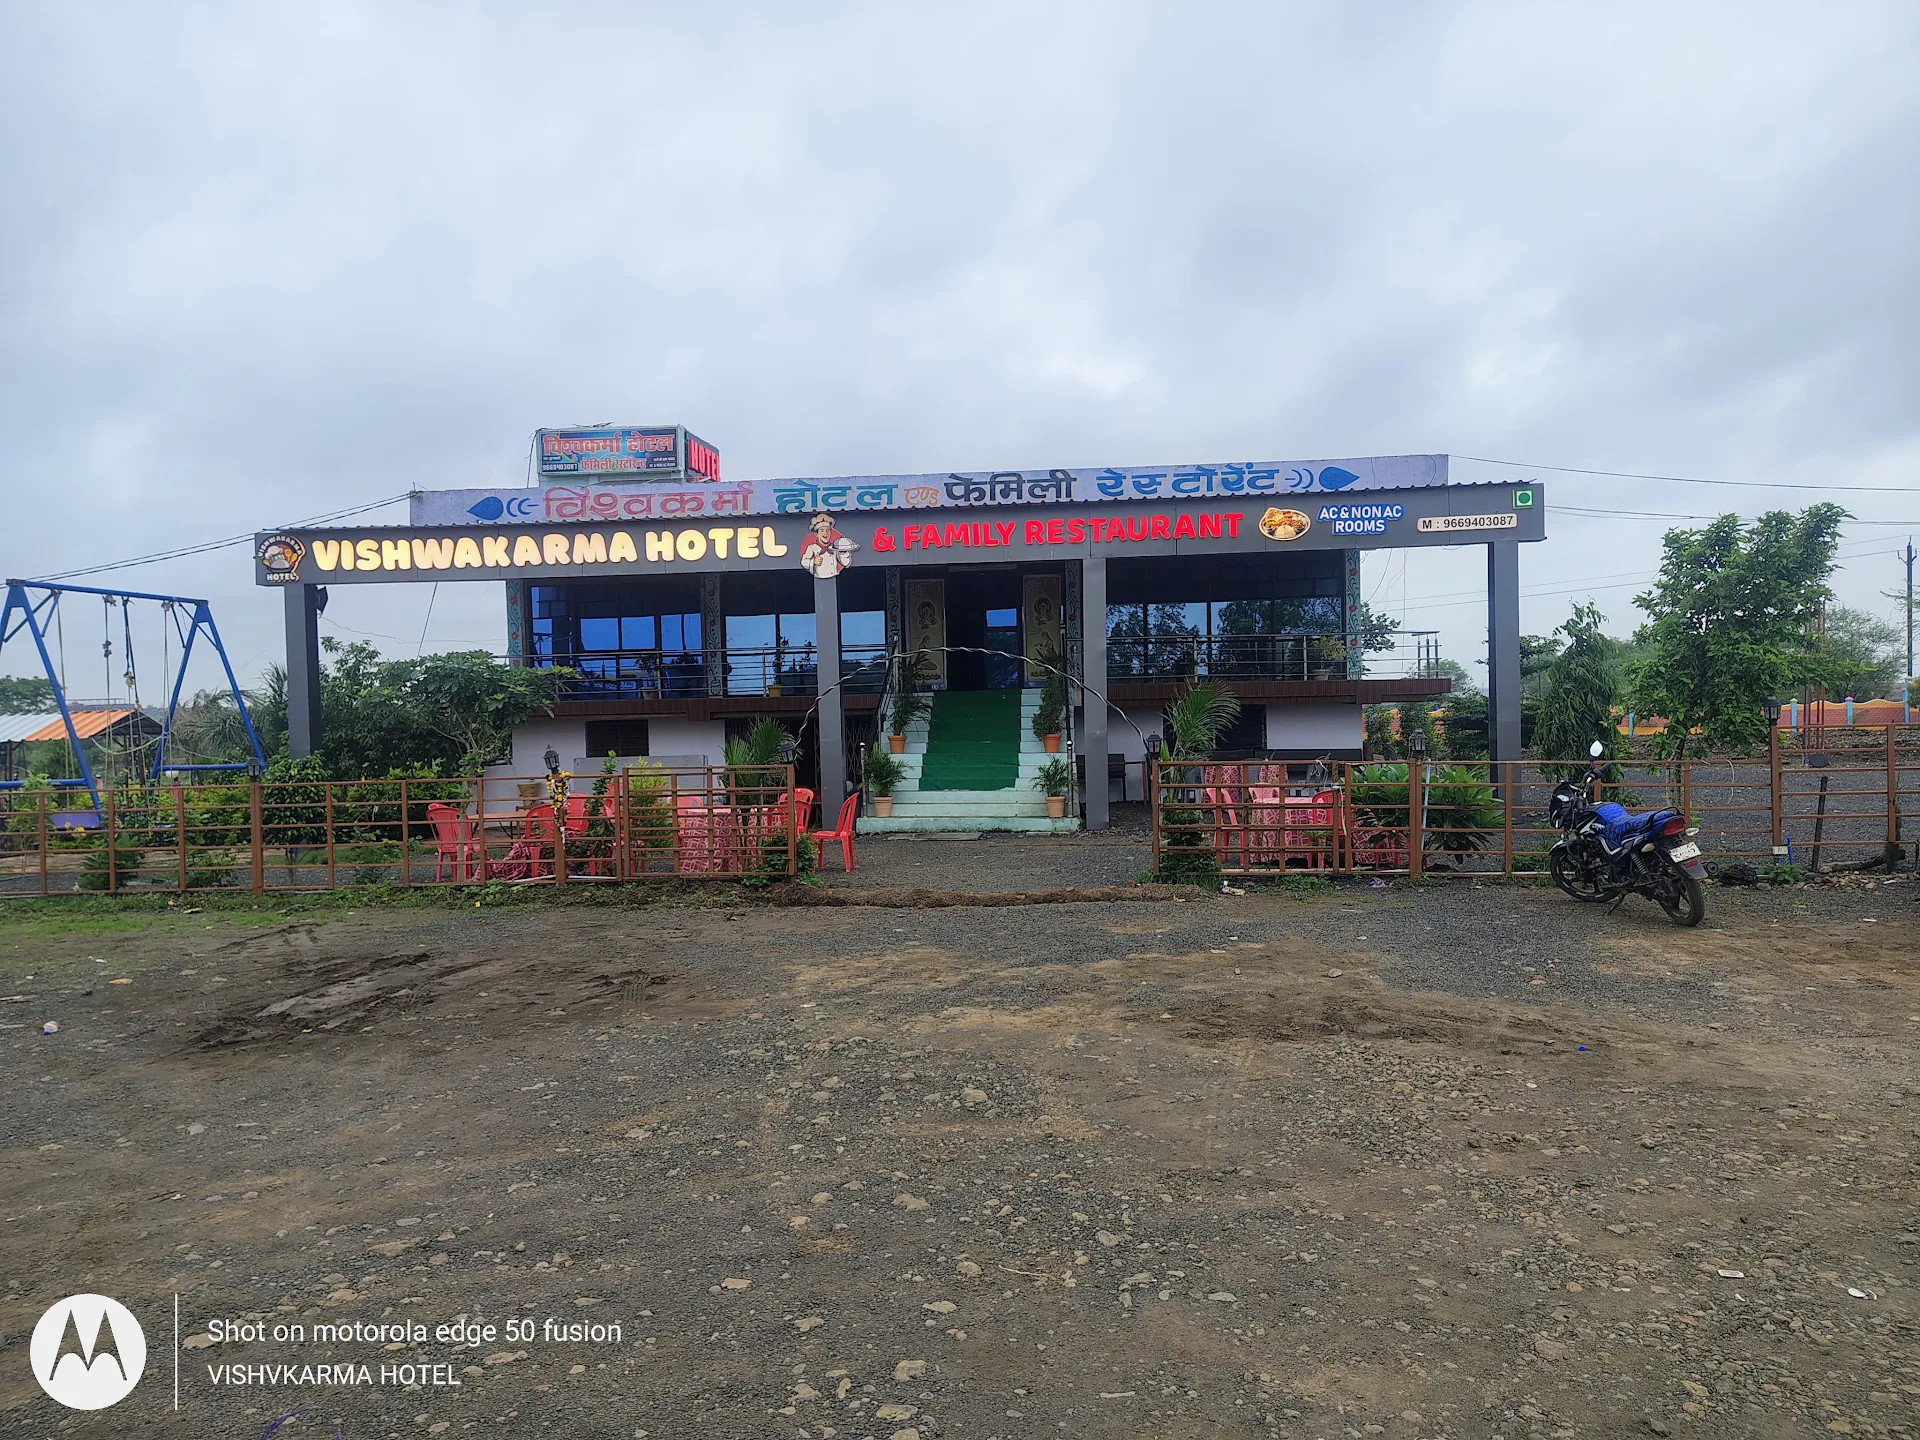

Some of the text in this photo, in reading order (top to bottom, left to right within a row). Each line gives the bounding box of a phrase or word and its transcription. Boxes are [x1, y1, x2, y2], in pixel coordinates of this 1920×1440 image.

[626, 431, 674, 452] होटल
[773, 480, 898, 512] होटल
[1351, 506, 1382, 518] NON
[1383, 505, 1402, 517] AC
[1335, 520, 1385, 533] ROOMS
[1422, 520, 1433, 530] M
[1443, 515, 1514, 529] 9669403087
[872, 513, 1244, 552] & FAMILY RESTAURANT
[312, 527, 789, 571] VISHWAKARMA HOTEL
[266, 573, 295, 581] HOTEL
